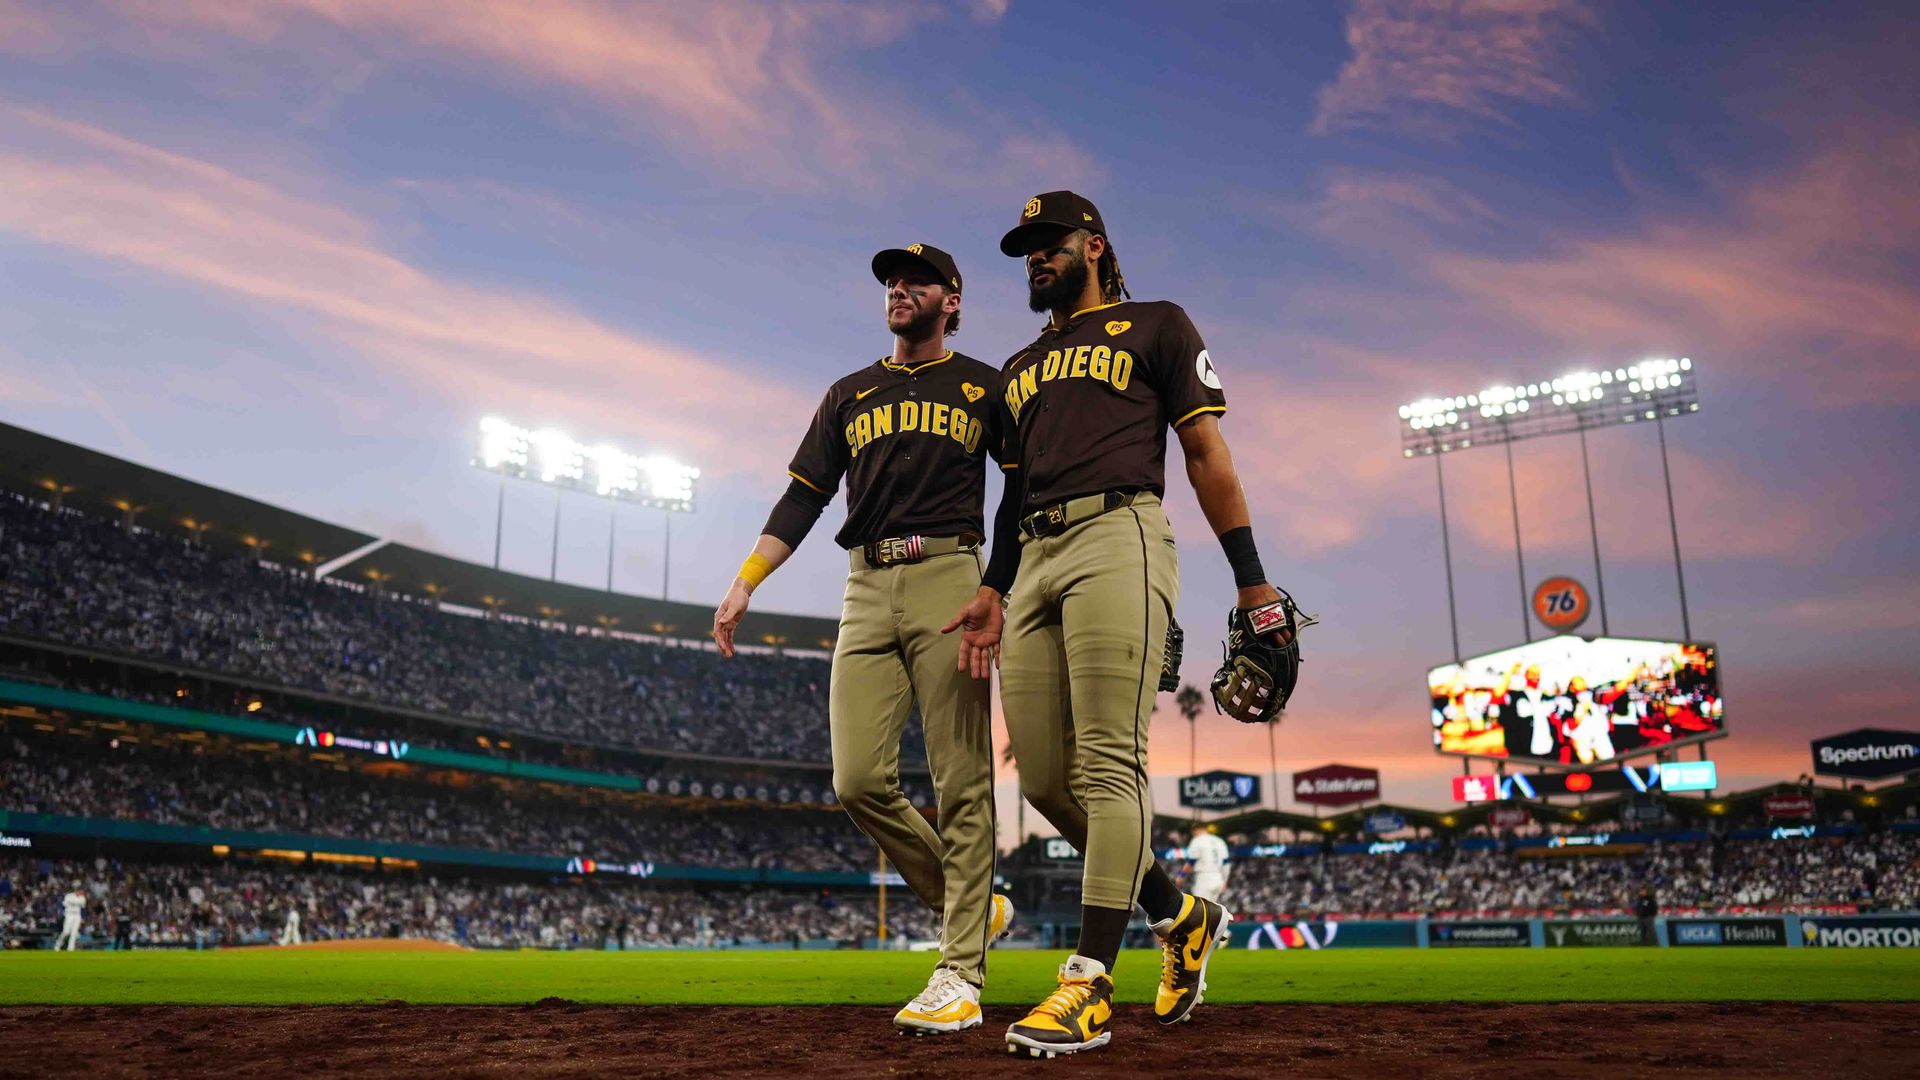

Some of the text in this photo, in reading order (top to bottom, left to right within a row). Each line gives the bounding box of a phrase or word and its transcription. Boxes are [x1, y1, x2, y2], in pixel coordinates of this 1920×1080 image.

[1110, 323, 1124, 332] PS
[967, 387, 979, 398] PS
[1005, 345, 1133, 426] AN DIEGO
[845, 400, 983, 458] SAN DIEGO
[1049, 510, 1062, 524] 23
[1545, 590, 1576, 613] 76
[1819, 744, 1914, 766] Spectrum
[1184, 779, 1231, 798] blue
[1681, 925, 1777, 941] UCLA Health
